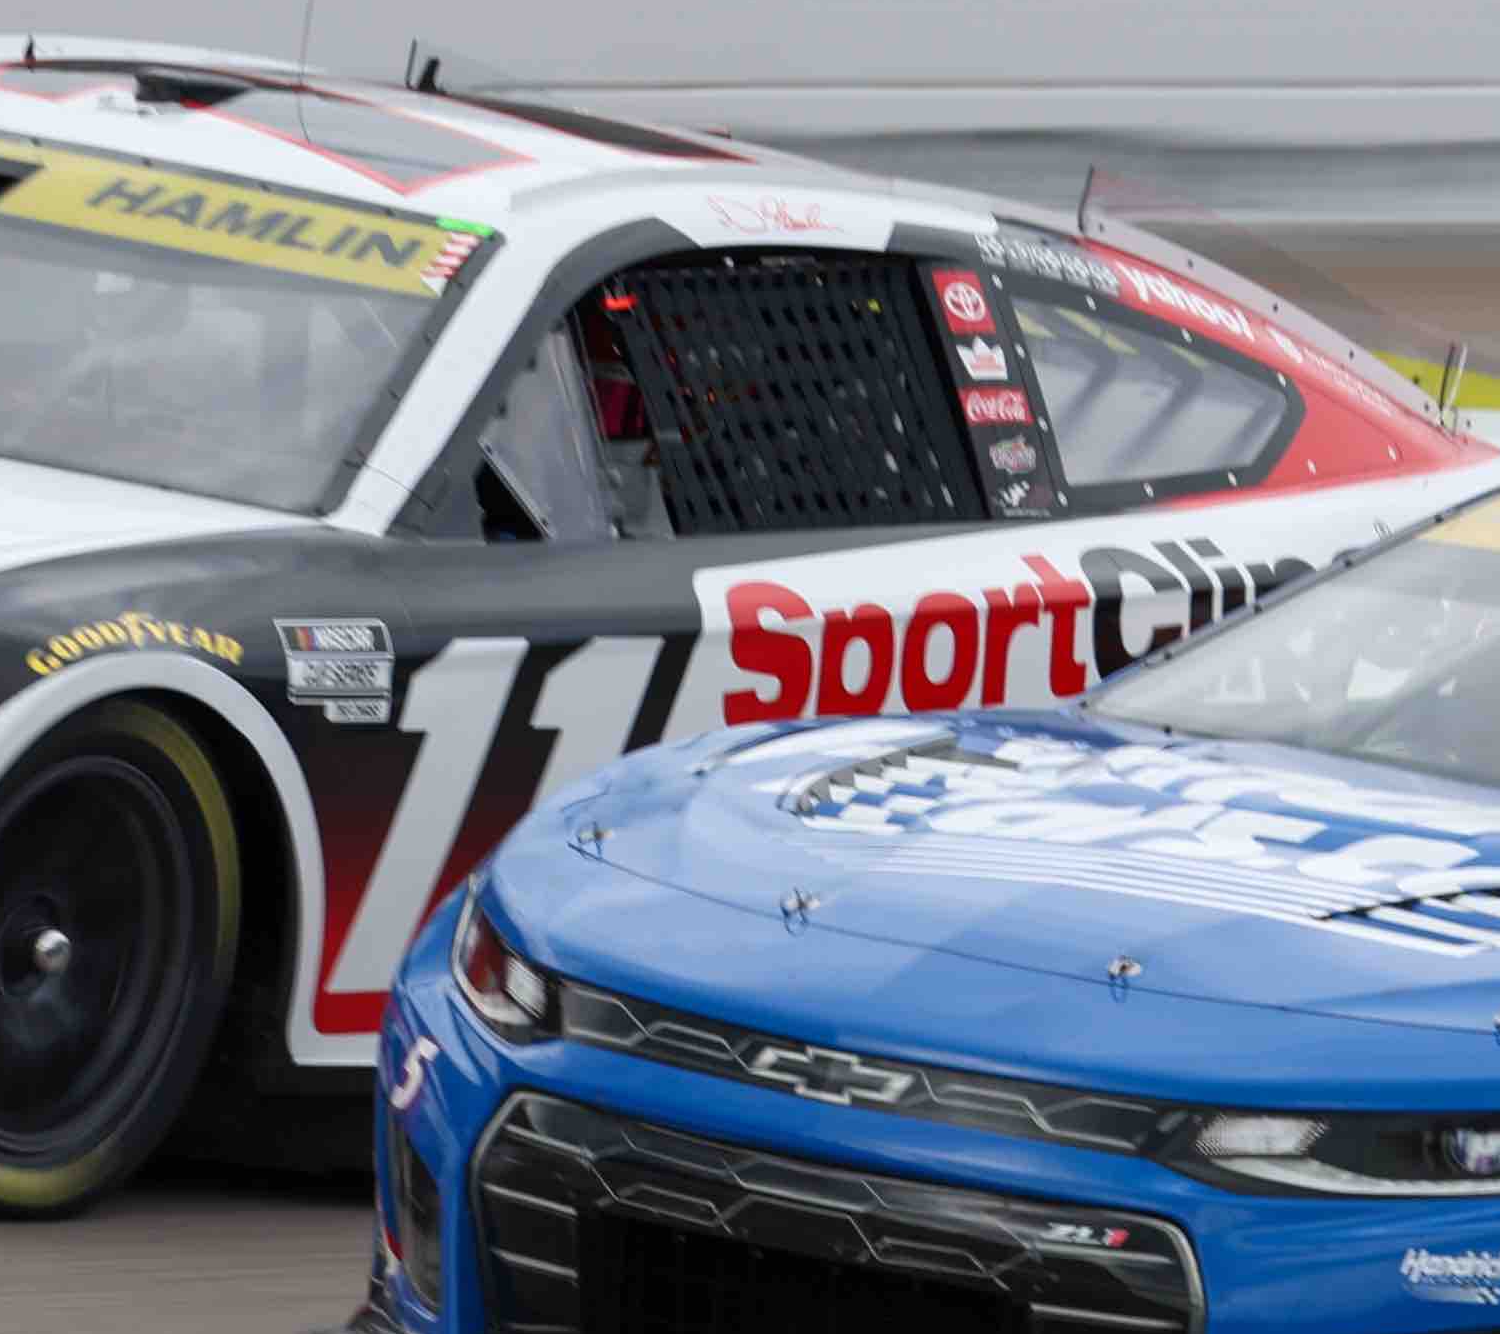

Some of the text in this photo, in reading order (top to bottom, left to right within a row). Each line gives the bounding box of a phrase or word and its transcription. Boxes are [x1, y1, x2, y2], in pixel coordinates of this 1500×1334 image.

[85, 175, 424, 269] HAMLIN
[25, 611, 244, 676] GOODYEAR
[324, 635, 666, 993] 11
